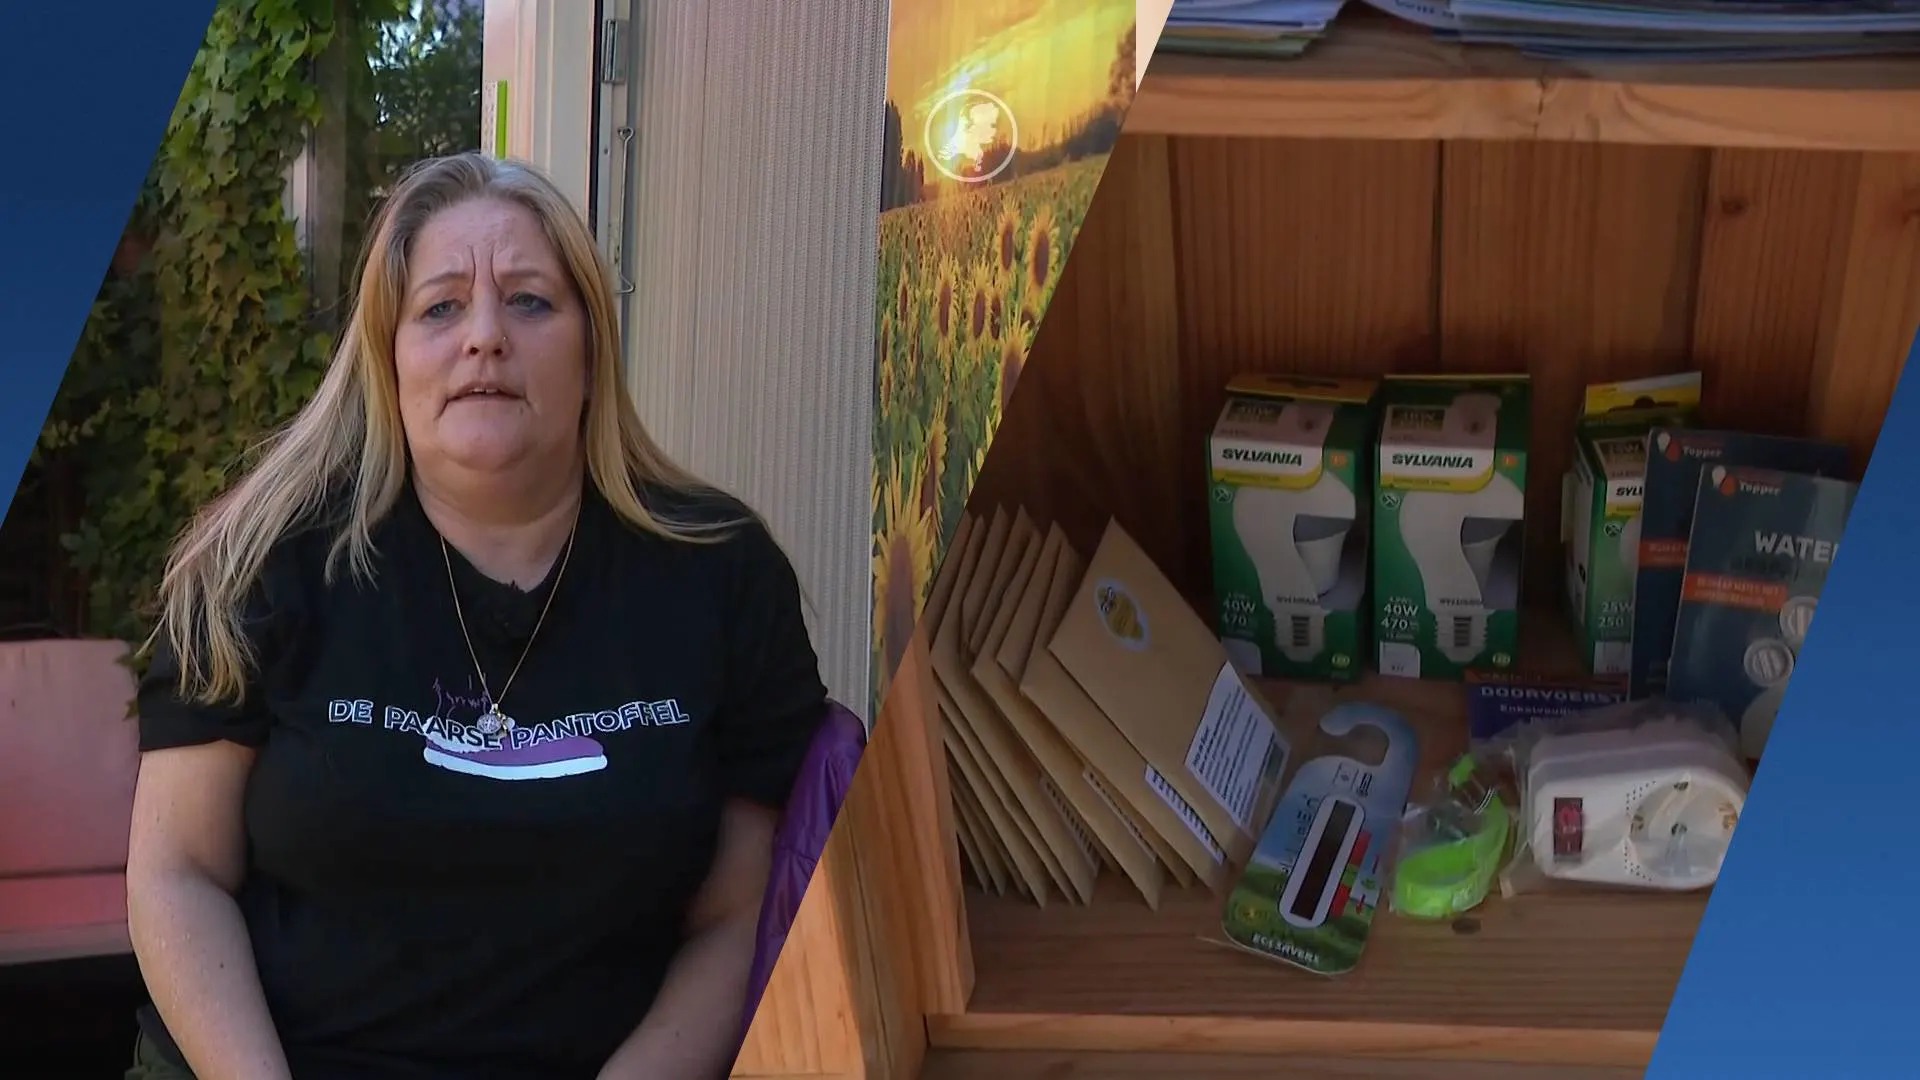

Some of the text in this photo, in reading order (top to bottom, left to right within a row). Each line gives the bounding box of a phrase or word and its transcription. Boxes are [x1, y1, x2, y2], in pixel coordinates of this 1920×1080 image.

[1222, 447, 1303, 467] SYLVANIA
[1681, 445, 1723, 459] Topper
[1392, 453, 1474, 469] SYLVANIA
[1739, 481, 1781, 497] Topper
[1223, 597, 1257, 614] 40W
[1383, 602, 1419, 617] 40W
[1220, 611, 1247, 627] 470
[1380, 616, 1409, 631] 470
[1598, 616, 1625, 628] 250
[329, 698, 691, 751] DE PAARSE PANTOFFEL
